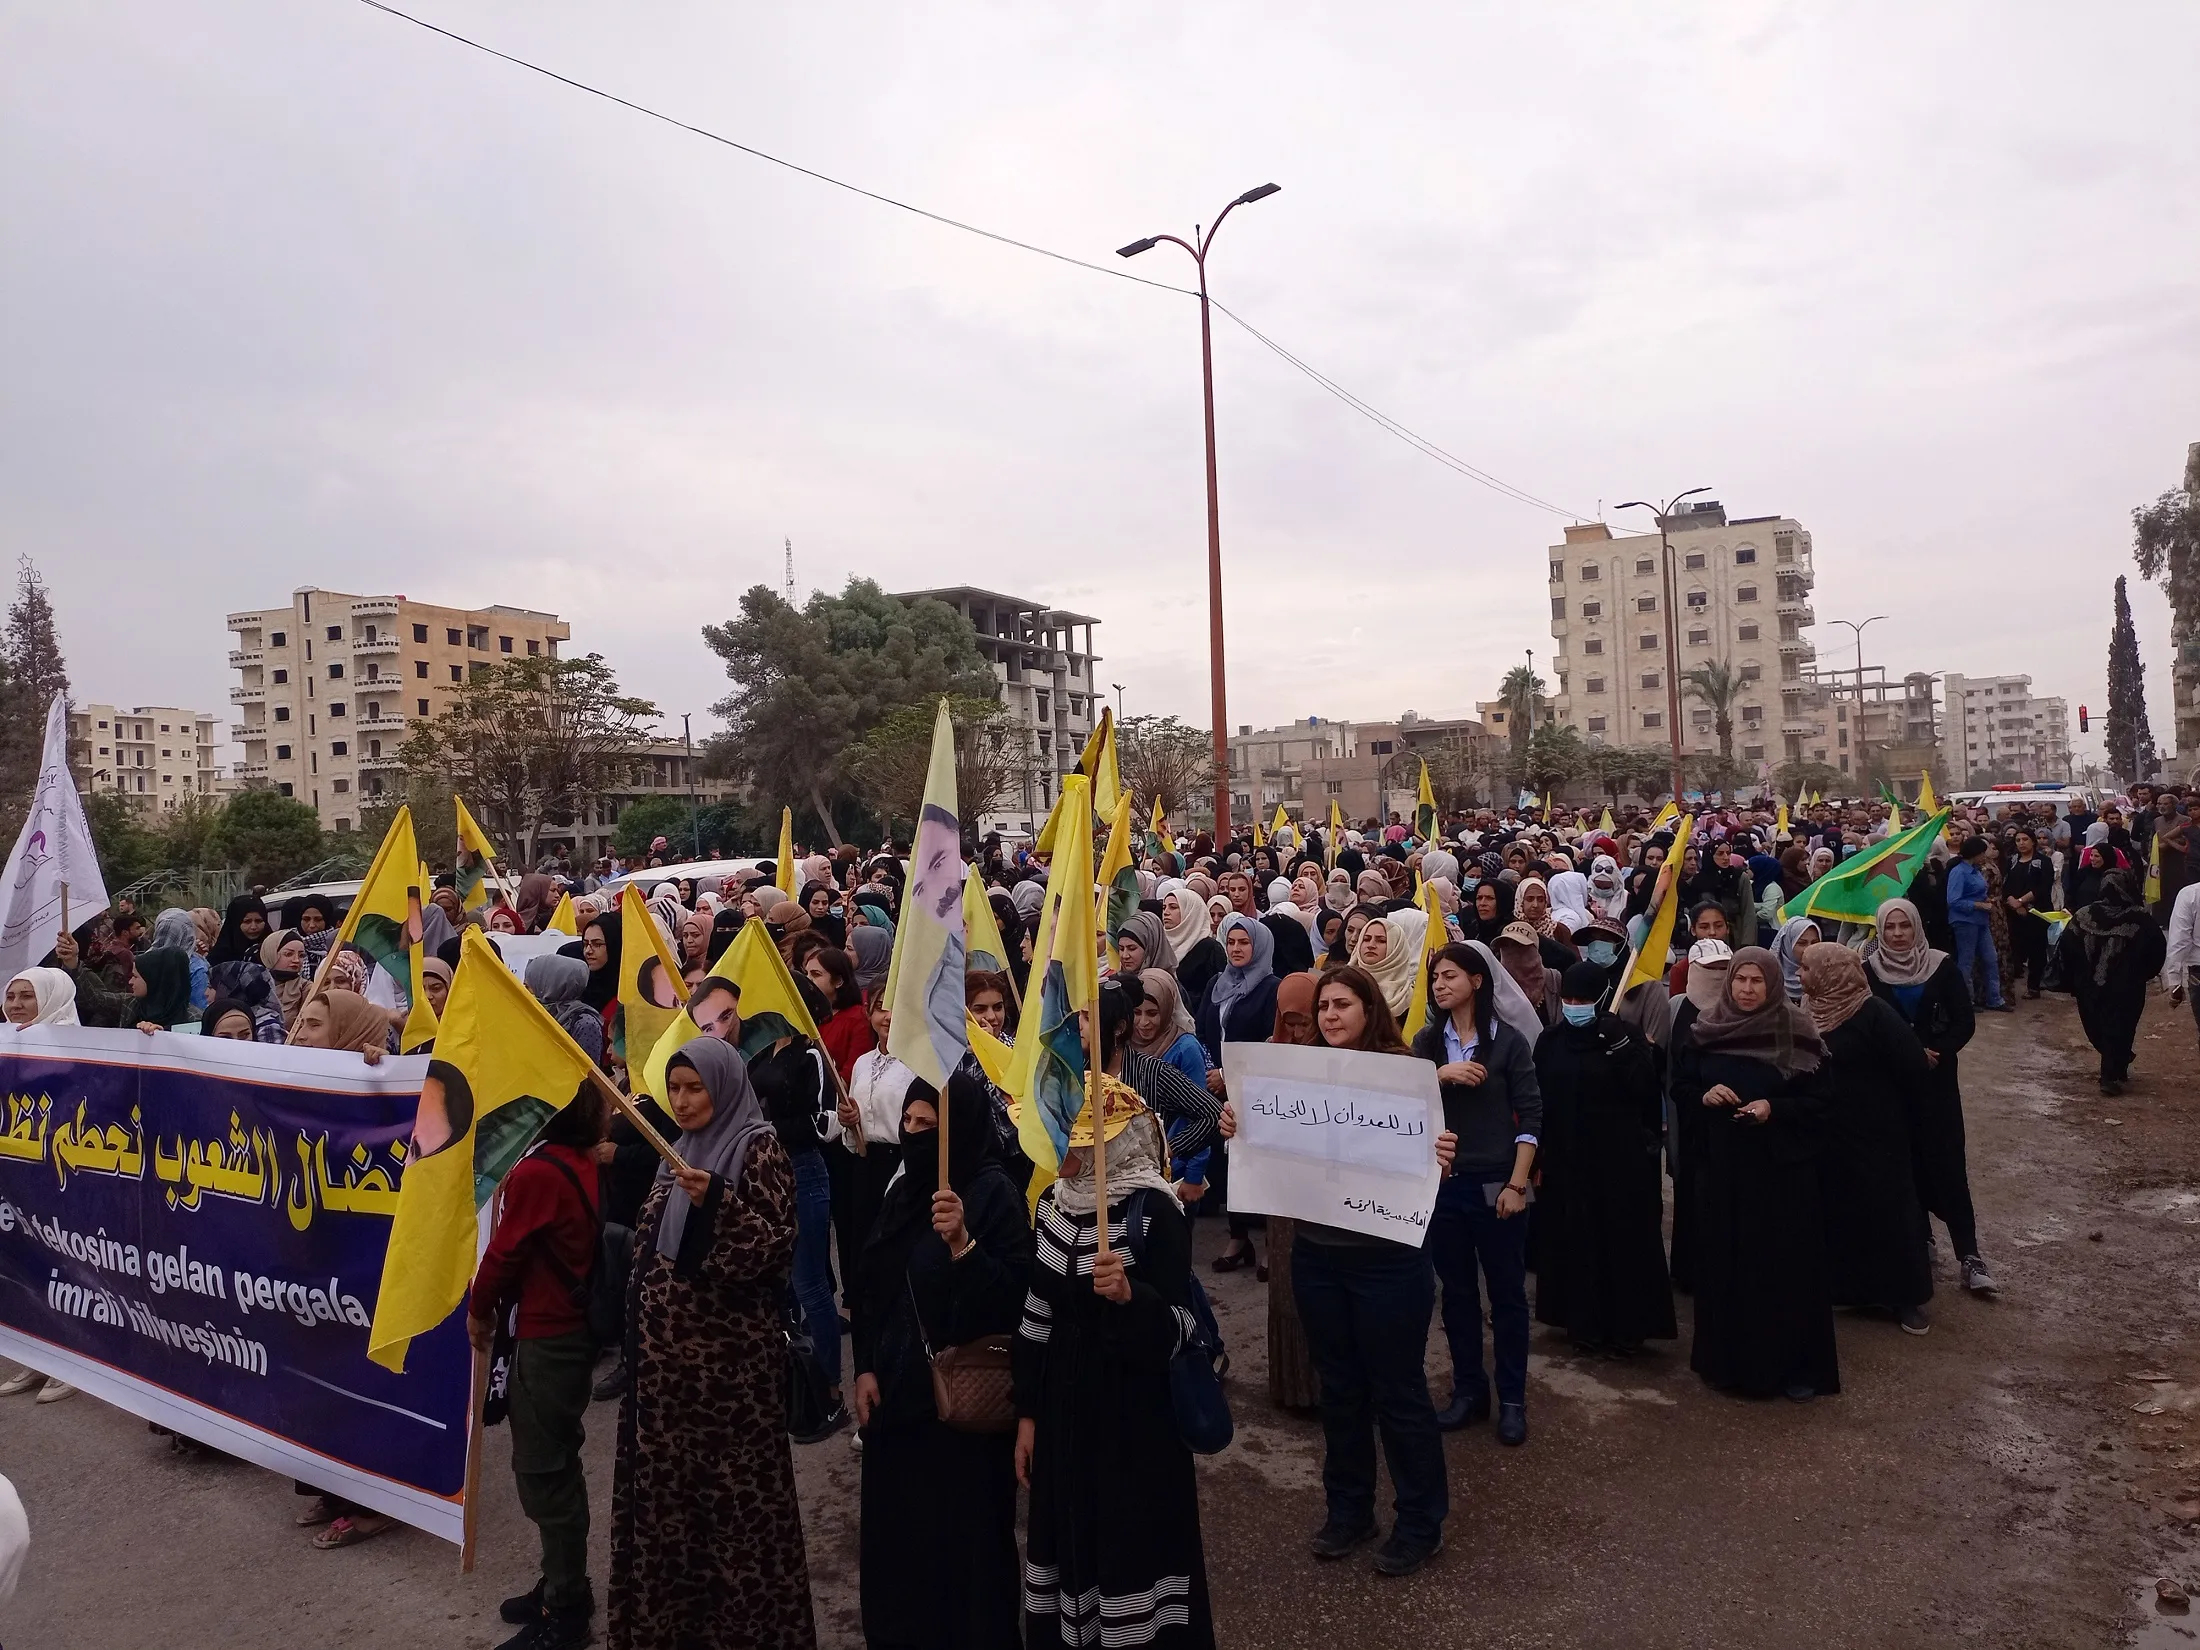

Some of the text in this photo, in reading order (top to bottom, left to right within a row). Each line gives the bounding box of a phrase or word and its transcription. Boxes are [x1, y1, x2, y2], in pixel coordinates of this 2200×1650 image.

[17, 570, 42, 583] 2023
[53, 1096, 145, 1191] نحطم
[1252, 1095, 1424, 1135] لا للعدوان لا للخيانة
[155, 1106, 281, 1213] الشعوب
[1343, 1197, 1376, 1214] الرقة
[1376, 1205, 1402, 1221] مدينة
[31, 1214, 140, 1277] tekoşîna
[147, 1245, 226, 1299] gelan
[234, 1270, 371, 1327] pergala
[119, 1294, 268, 1376] hilweşînin
